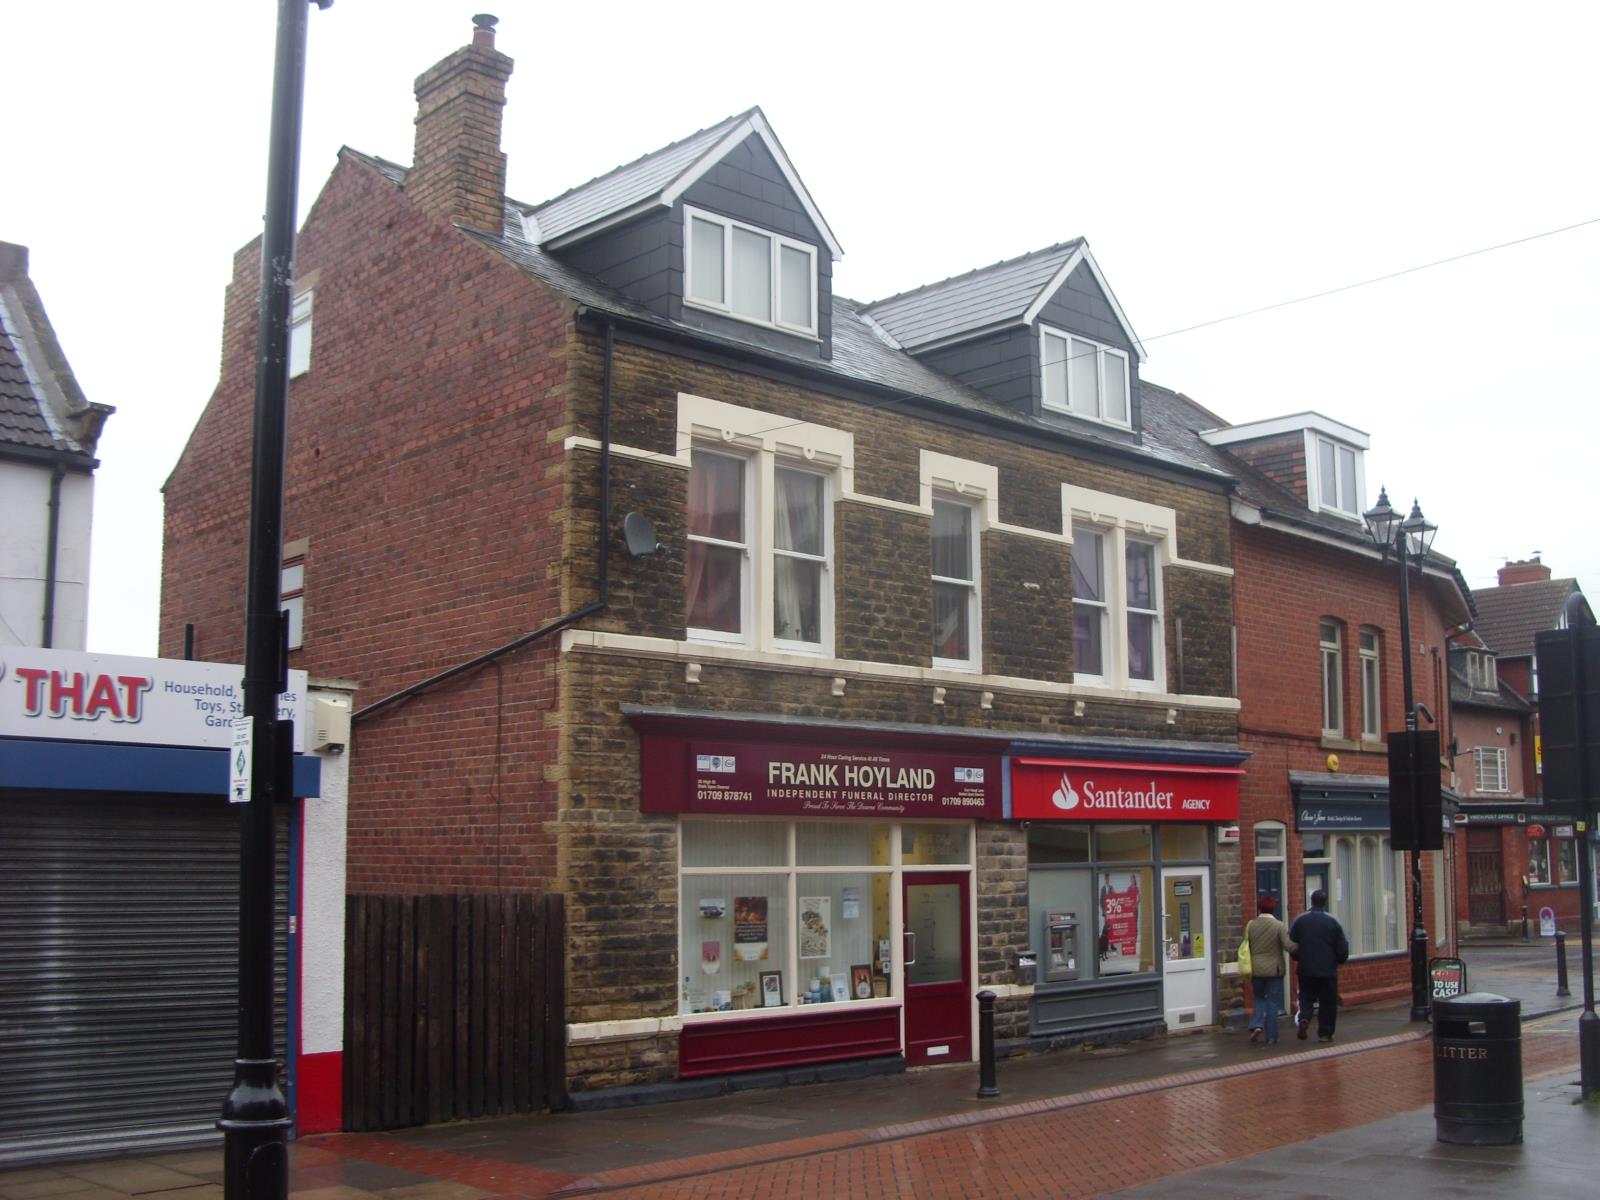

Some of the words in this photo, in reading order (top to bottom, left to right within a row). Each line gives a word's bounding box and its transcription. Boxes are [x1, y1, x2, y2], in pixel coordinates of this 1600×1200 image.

[15, 667, 150, 720] THAT
[164, 681, 237, 698] Household,
[194, 698, 226, 714] Toys,
[768, 762, 839, 786] FRANK
[845, 765, 936, 790] HOYLAND
[697, 790, 723, 800] 01709
[724, 791, 752, 801] 878741
[767, 788, 838, 799] INDEPENDENT
[842, 791, 884, 801] FUNERAL
[888, 792, 934, 802] DIRECTOR
[942, 797, 961, 806] 01709
[1083, 780, 1174, 809] Santander
[1182, 799, 1211, 809] AGENCY
[1105, 898, 1122, 914] 3%
[1432, 988, 1459, 998] CASH
[1434, 981, 1444, 989] TO
[1444, 981, 1459, 989] USE
